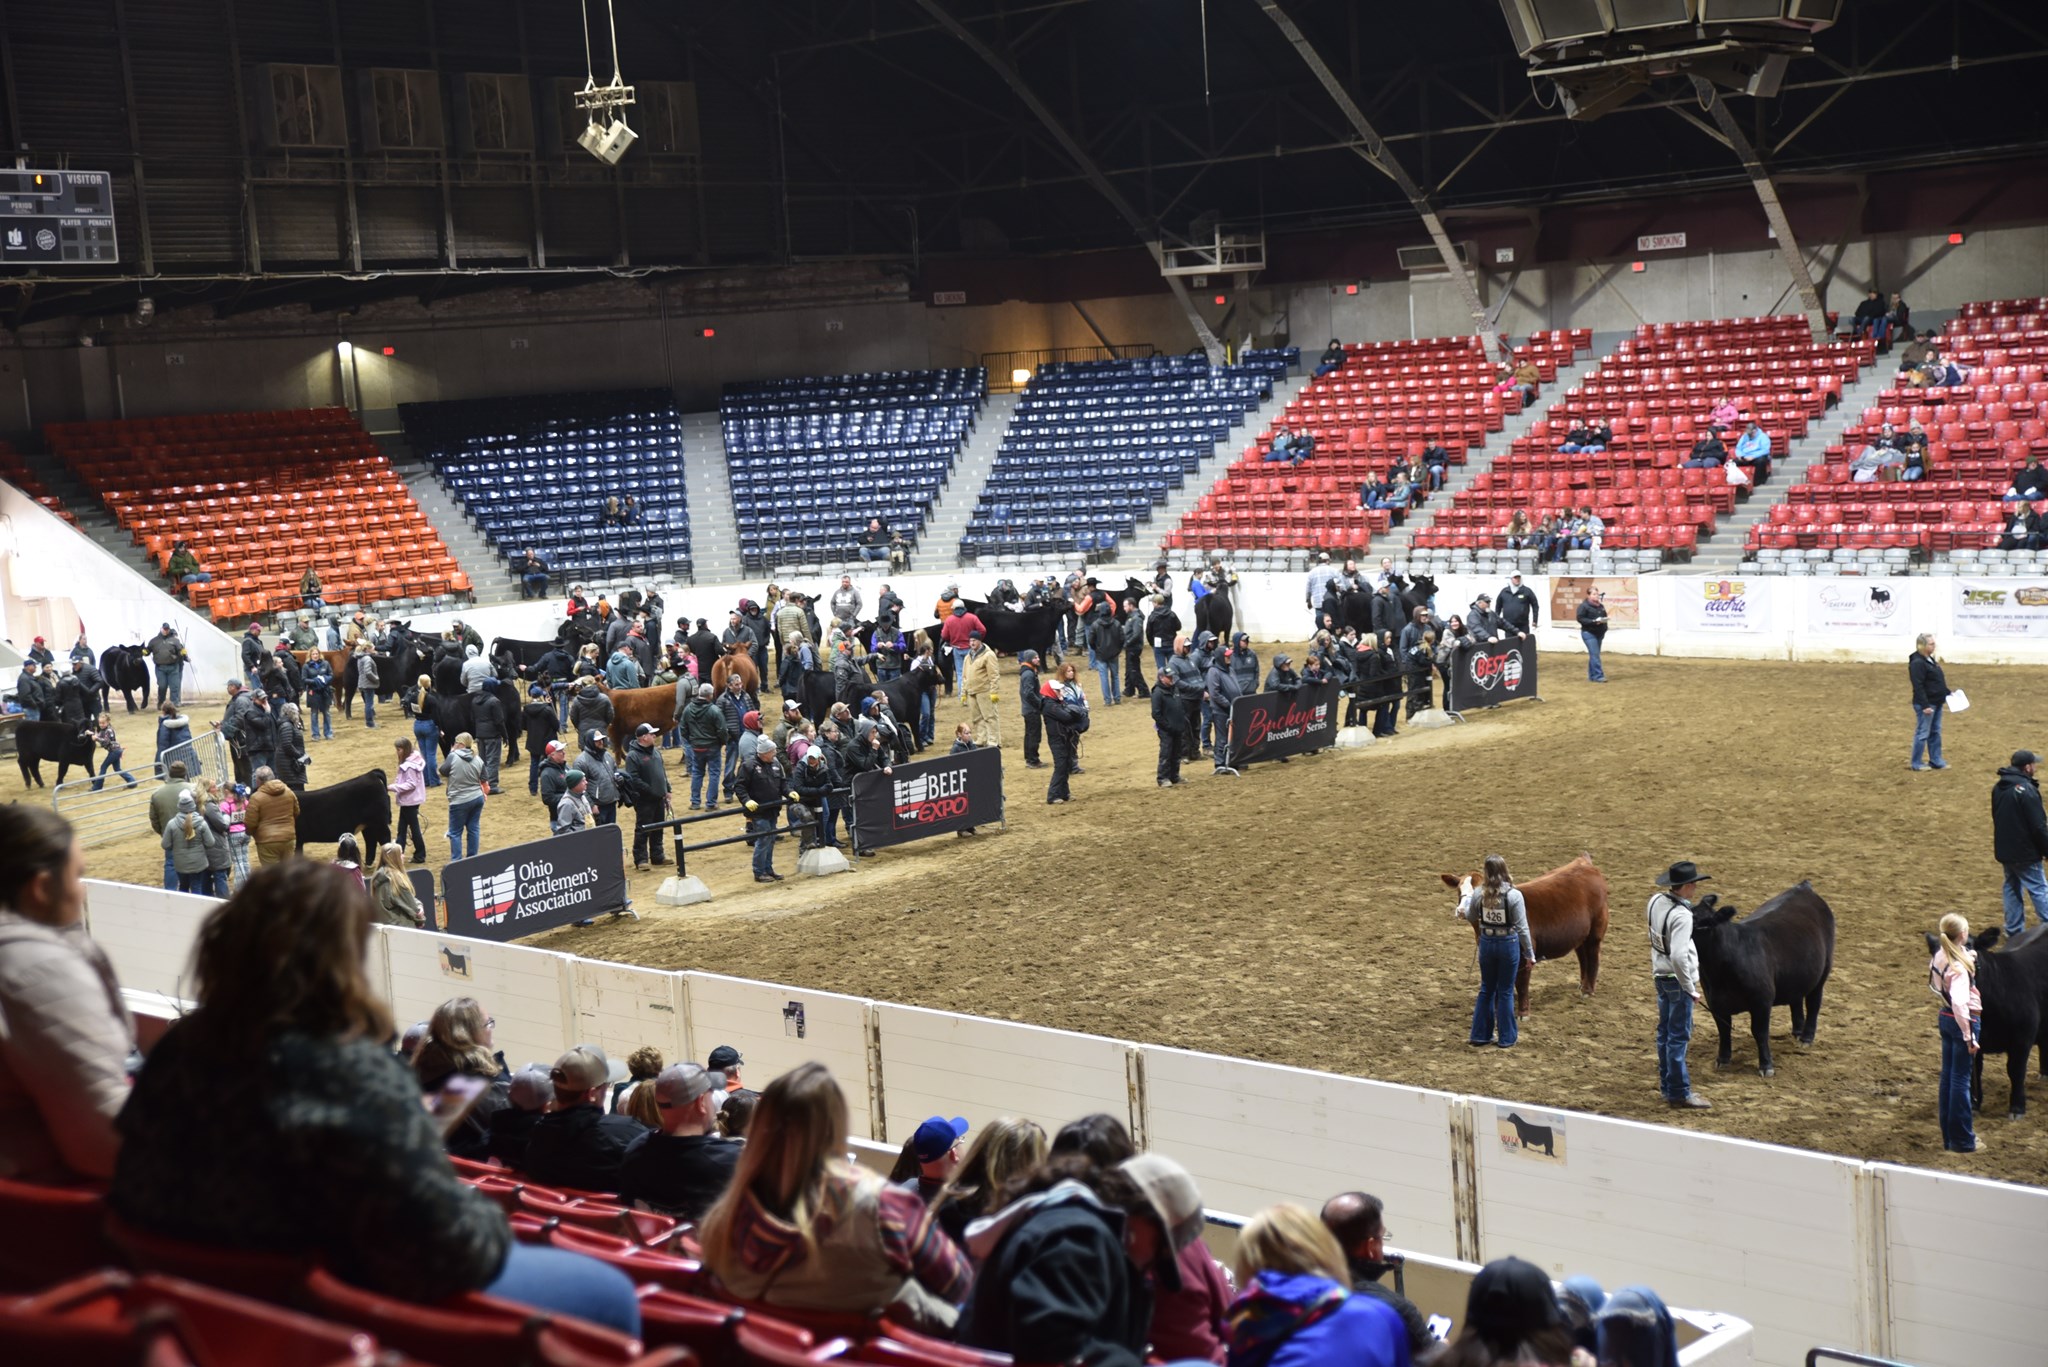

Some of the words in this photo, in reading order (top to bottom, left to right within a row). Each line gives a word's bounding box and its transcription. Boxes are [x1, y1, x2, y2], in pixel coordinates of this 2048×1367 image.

[66, 173, 103, 185] VISITOR
[10, 201, 33, 209] PERIOD
[1639, 237, 1651, 249] NO
[1652, 234, 1684, 248] SMOKING
[1476, 653, 1509, 678] BEST
[1244, 701, 1317, 747] Buckeye
[1306, 720, 1328, 733] Series
[927, 768, 969, 800] BEEF
[917, 796, 969, 822] EXPO
[518, 858, 554, 882] Ohio
[518, 866, 600, 901] Cattlemen's
[513, 887, 593, 920] Association
[1485, 912, 1502, 922] 426
[1500, 1134, 1521, 1144] WALK
